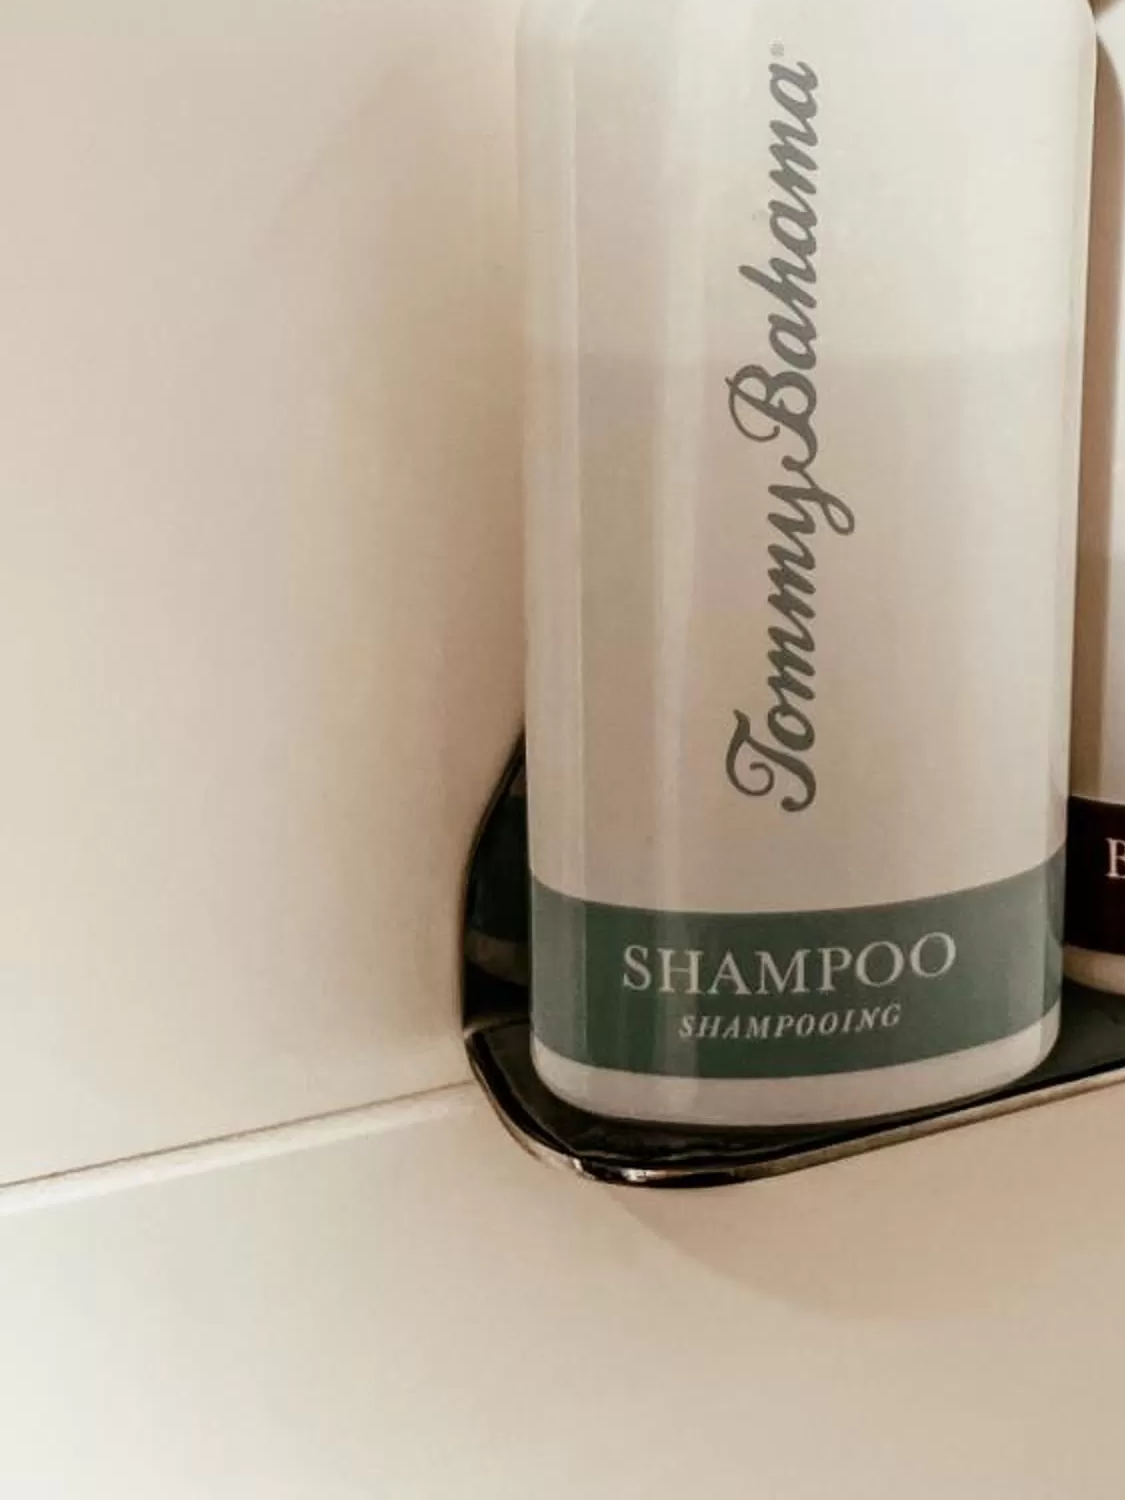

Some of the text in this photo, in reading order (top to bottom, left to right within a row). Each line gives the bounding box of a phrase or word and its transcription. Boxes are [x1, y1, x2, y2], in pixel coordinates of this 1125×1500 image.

[724, 467, 855, 813] Tommy
[622, 931, 957, 996] SHAMPOO
[678, 1003, 902, 1040] SHAMPOOING
